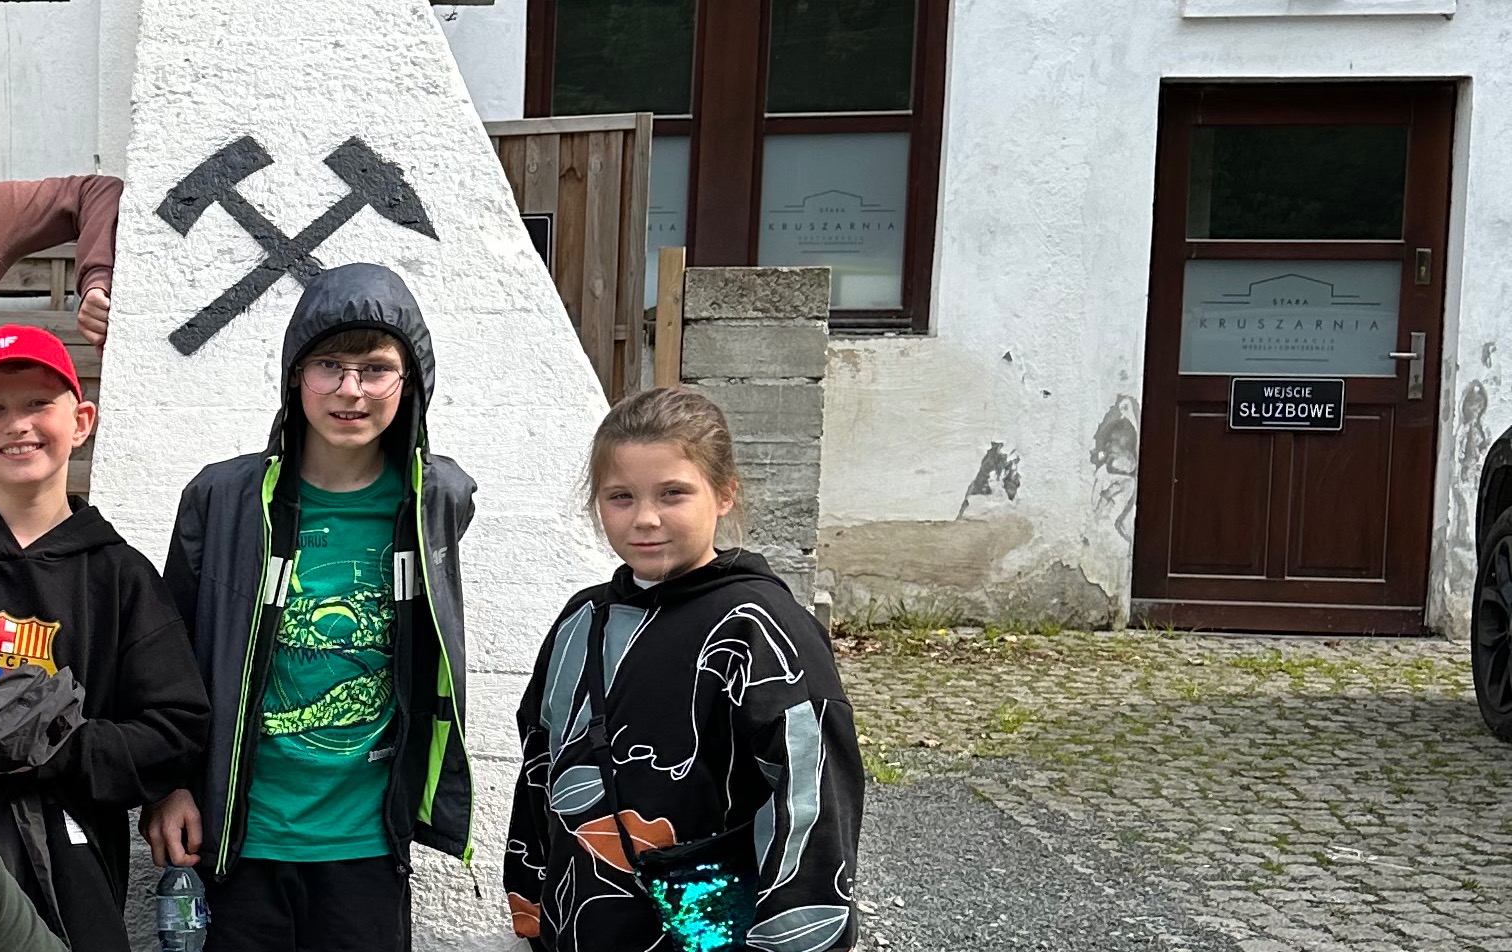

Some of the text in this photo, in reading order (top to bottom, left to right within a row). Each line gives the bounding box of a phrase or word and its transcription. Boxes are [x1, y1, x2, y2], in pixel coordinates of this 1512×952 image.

[768, 222, 896, 231] KRUSZARNIA
[1272, 298, 1310, 306] STARA
[1199, 318, 1379, 331] KRUSZARNIA
[1263, 385, 1313, 399] WEJŚCIE
[1239, 401, 1335, 418] SŁUŻBOWE
